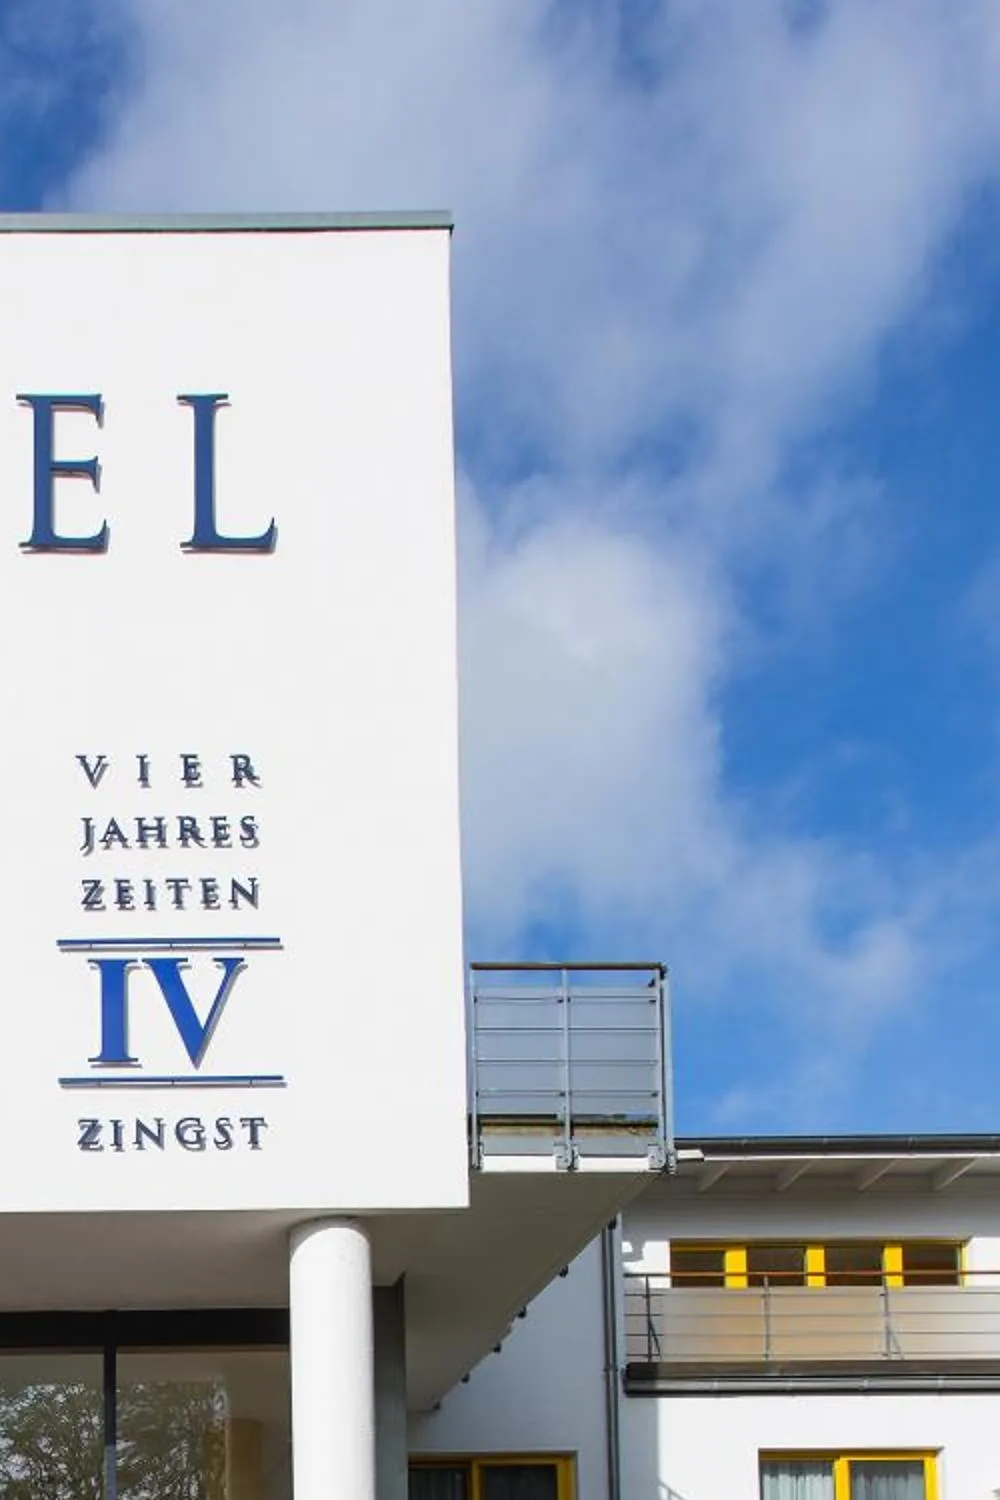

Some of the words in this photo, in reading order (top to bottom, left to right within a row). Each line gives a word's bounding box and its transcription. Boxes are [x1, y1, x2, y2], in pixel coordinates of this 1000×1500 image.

[76, 754, 258, 786] VIER
[81, 815, 257, 850] JAHRES
[81, 878, 257, 908] ZEITEN
[87, 957, 245, 1066] IV
[77, 1117, 265, 1149] ZINGST
